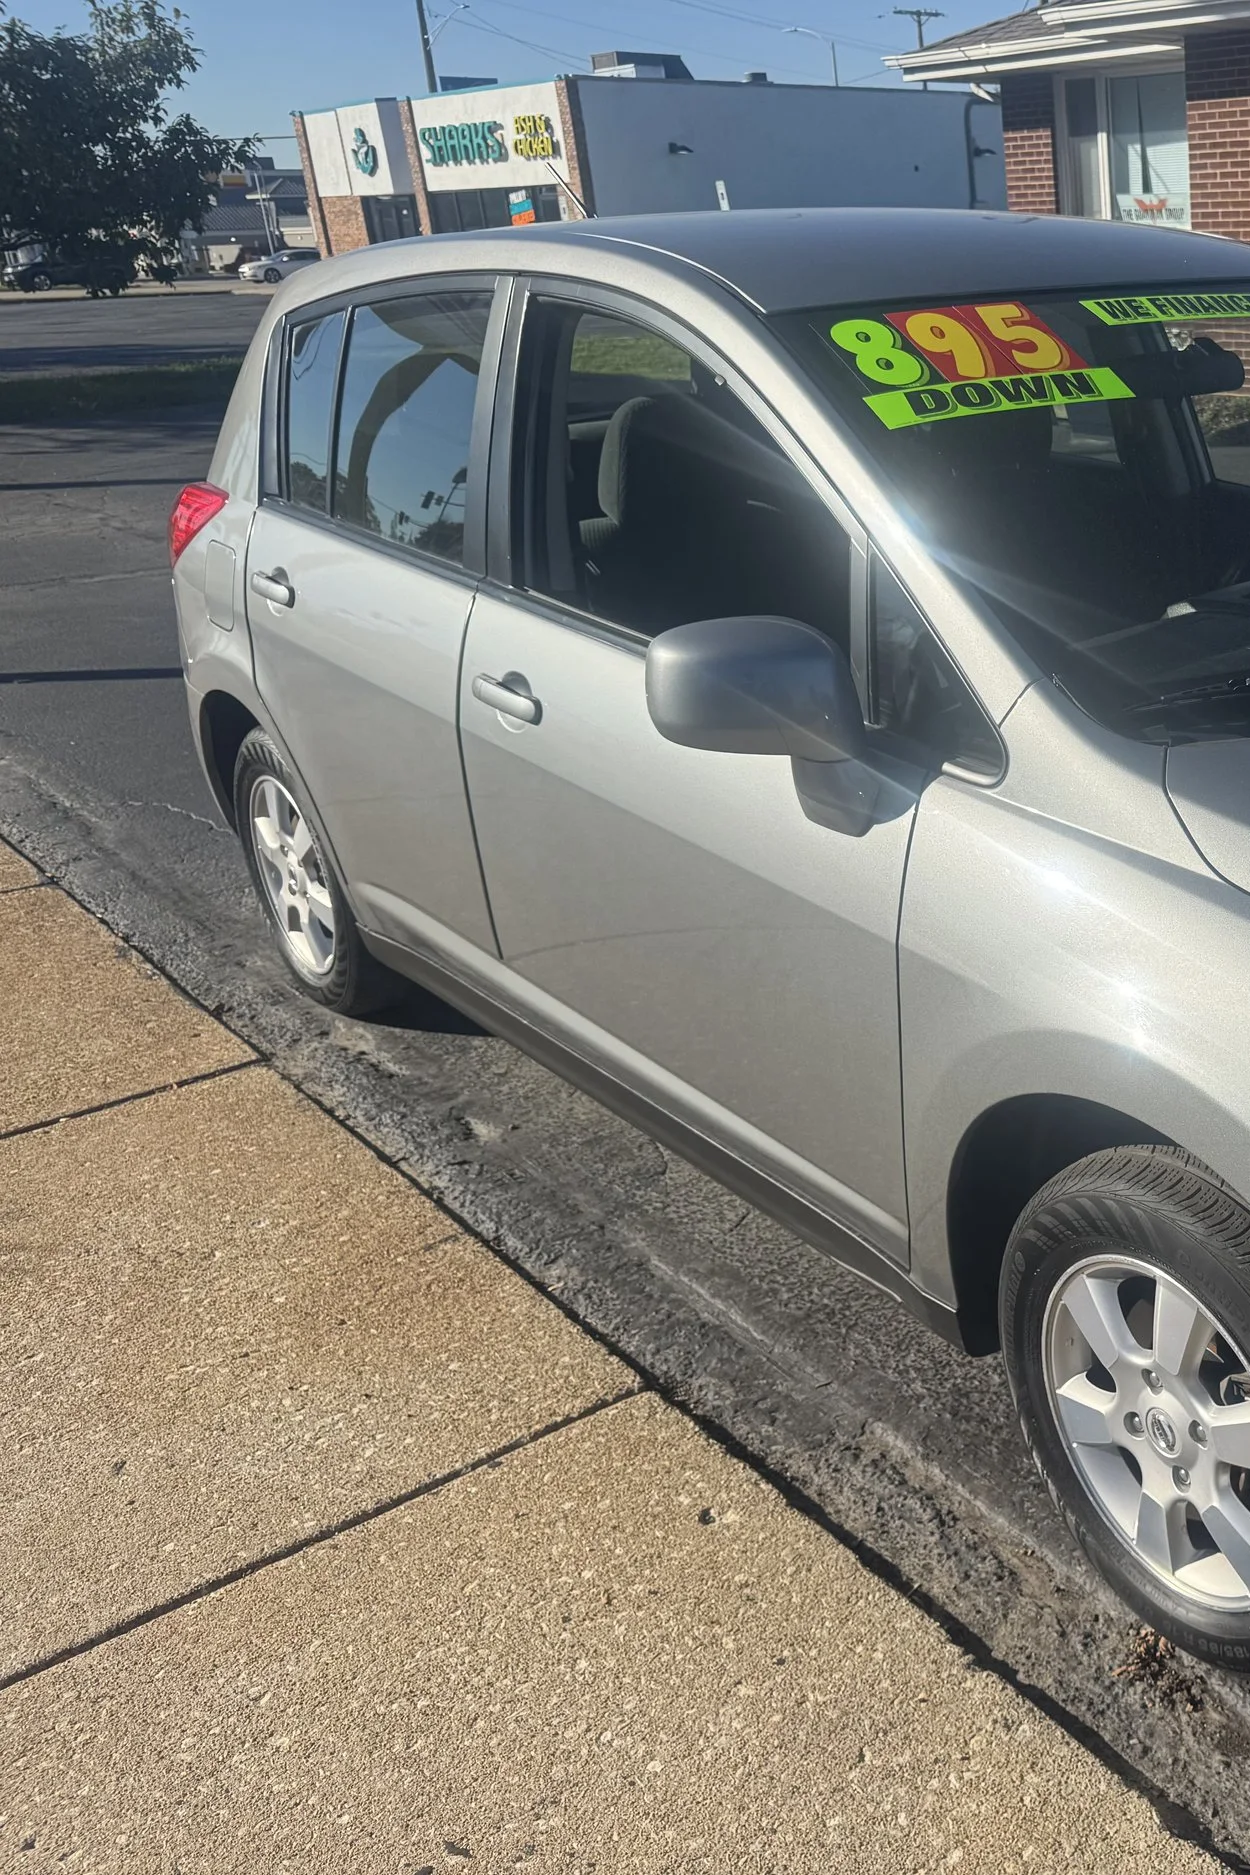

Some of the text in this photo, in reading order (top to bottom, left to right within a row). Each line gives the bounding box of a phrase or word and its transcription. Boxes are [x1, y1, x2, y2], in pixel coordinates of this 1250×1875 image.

[419, 121, 500, 163] SHARKS
[513, 136, 553, 157] CHICKEN
[1094, 299, 1159, 322] WE
[830, 304, 1070, 387] 895
[904, 371, 1103, 418] DOWN
